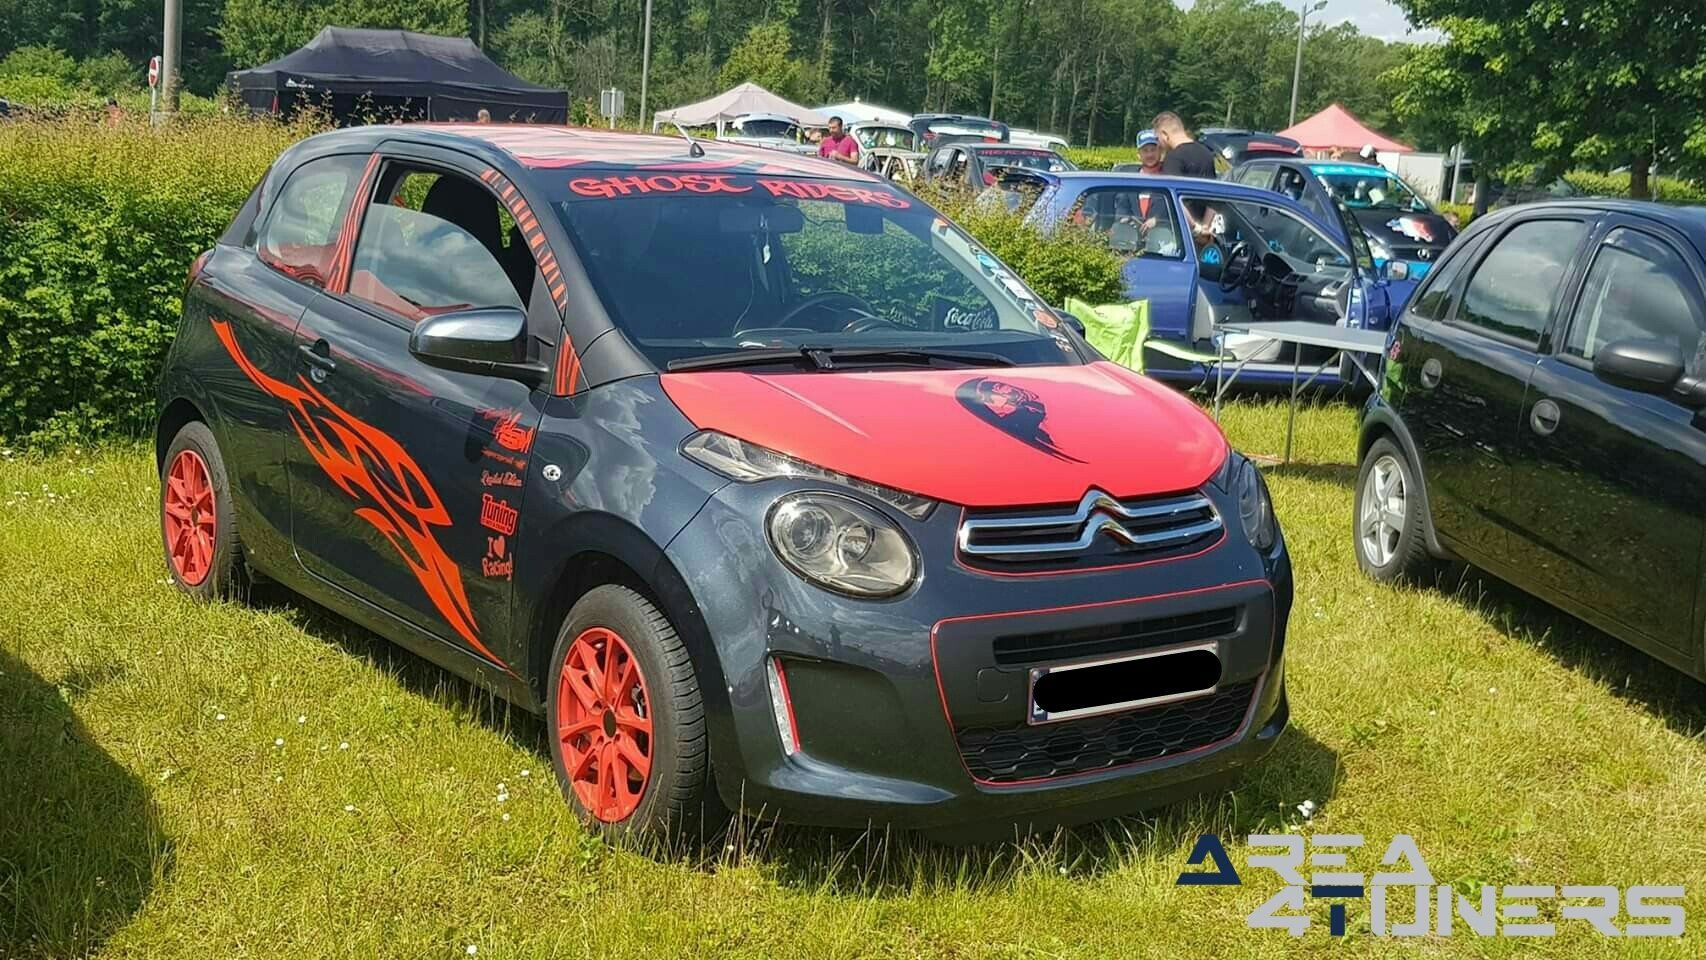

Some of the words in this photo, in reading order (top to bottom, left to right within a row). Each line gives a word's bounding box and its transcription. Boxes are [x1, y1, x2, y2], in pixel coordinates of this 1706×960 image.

[569, 175, 752, 198] GHOST
[757, 179, 911, 209] RIDERS
[483, 495, 516, 532] Tuning
